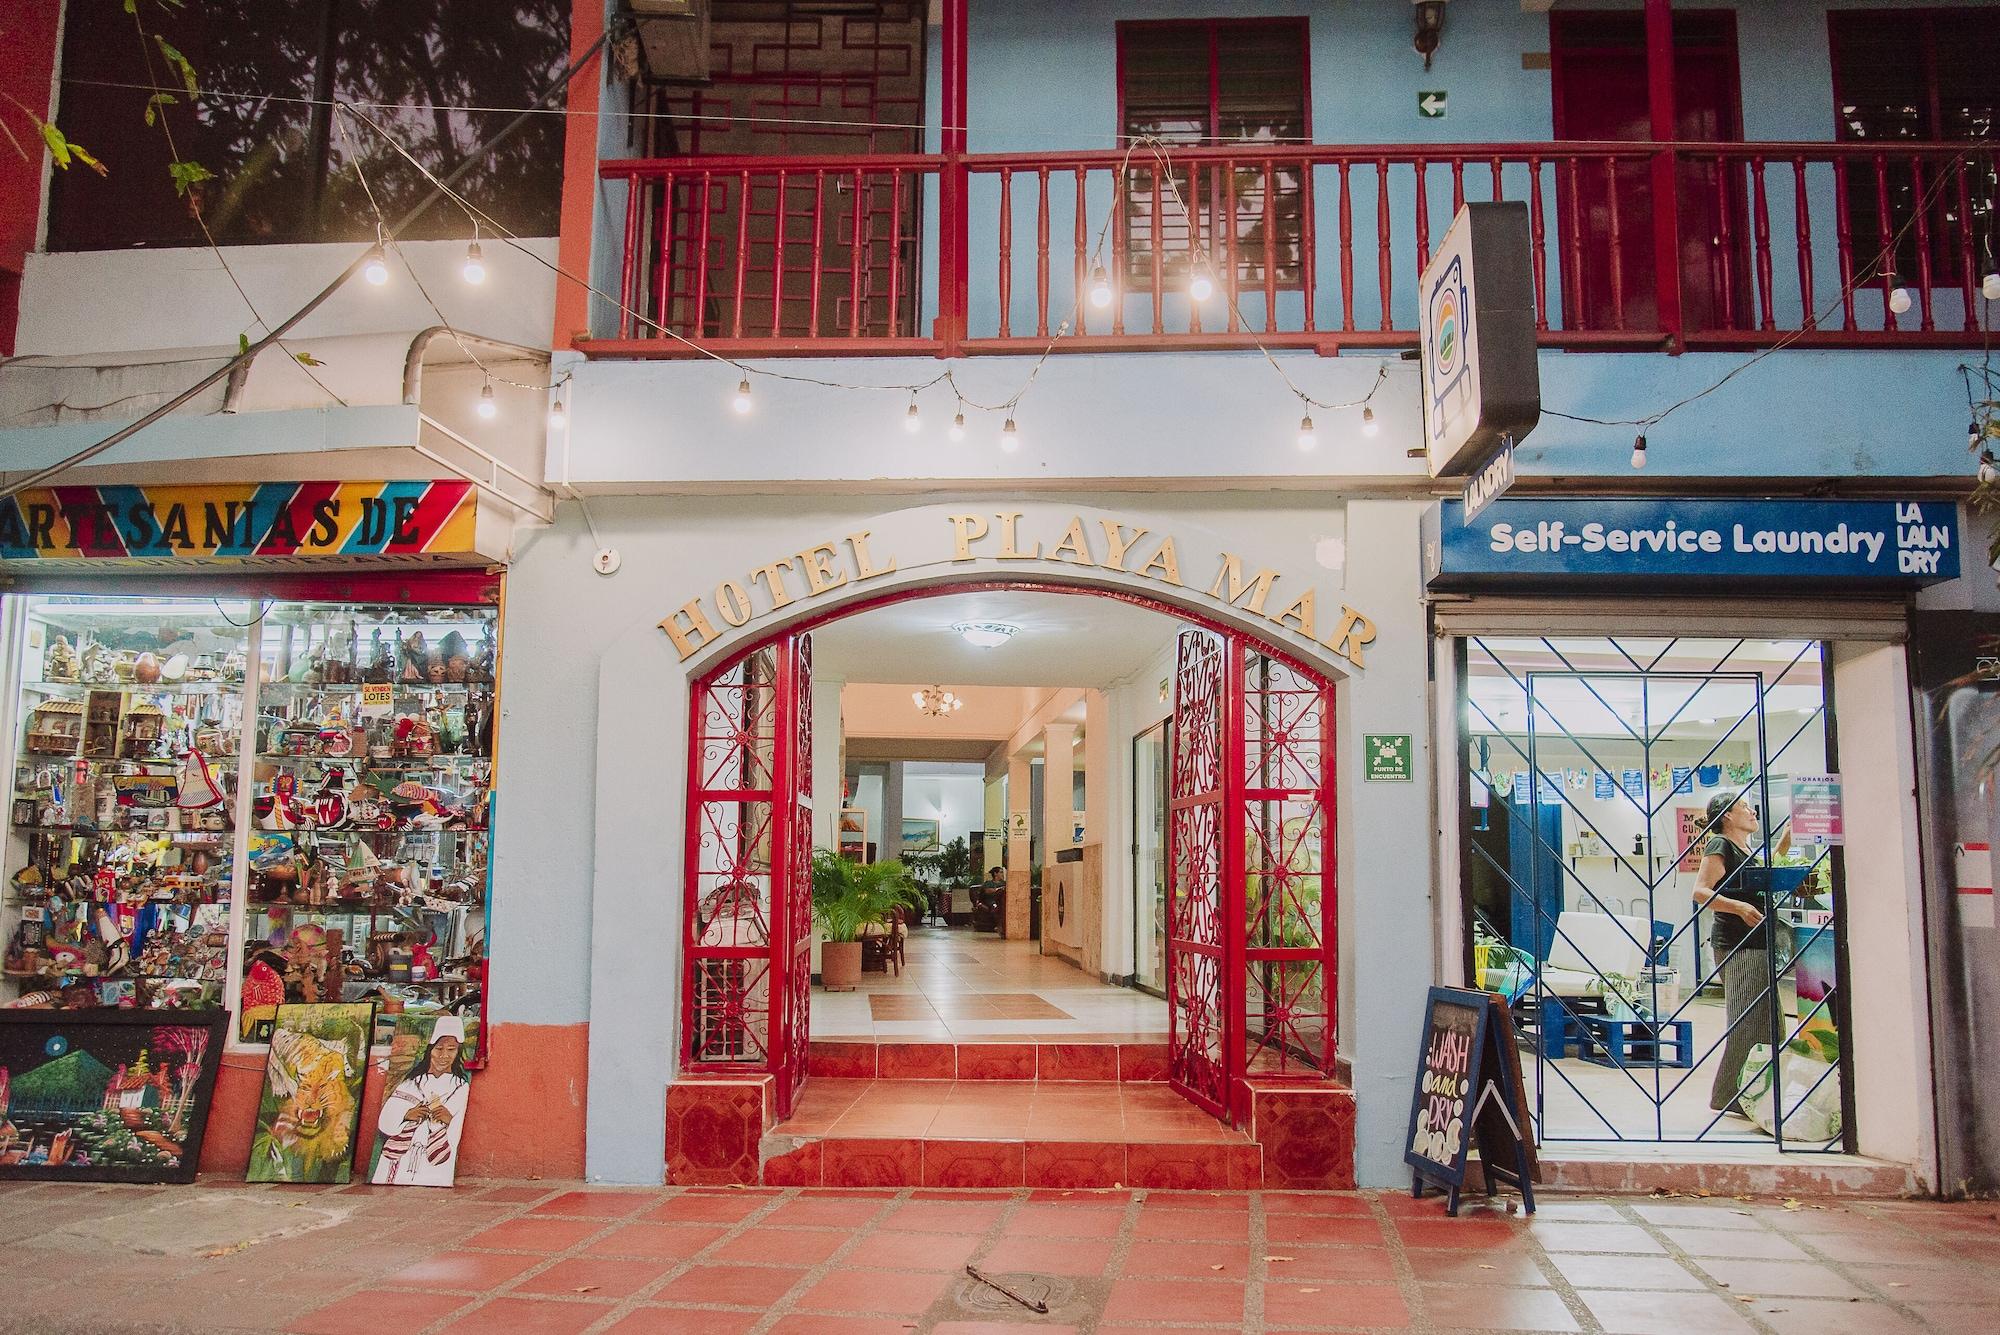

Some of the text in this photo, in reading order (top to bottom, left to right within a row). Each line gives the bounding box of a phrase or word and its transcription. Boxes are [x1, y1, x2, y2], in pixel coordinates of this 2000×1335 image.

[1464, 448, 1510, 518] LAUNDRY
[0, 496, 419, 549] ARTESANIAS DE
[1895, 502, 1923, 524] LA
[1490, 520, 1885, 563] Self-Service Laundry
[1896, 525, 1949, 549] LAUN
[1897, 550, 1941, 574] DRY
[657, 511, 1377, 670] HOTEL PLAYA MAR
[364, 692, 391, 701] LOTES
[95, 876, 110, 887] UNO
[1431, 1029, 1470, 1073] WASH
[1432, 1072, 1458, 1098] and
[1427, 1095, 1455, 1132] DRY
